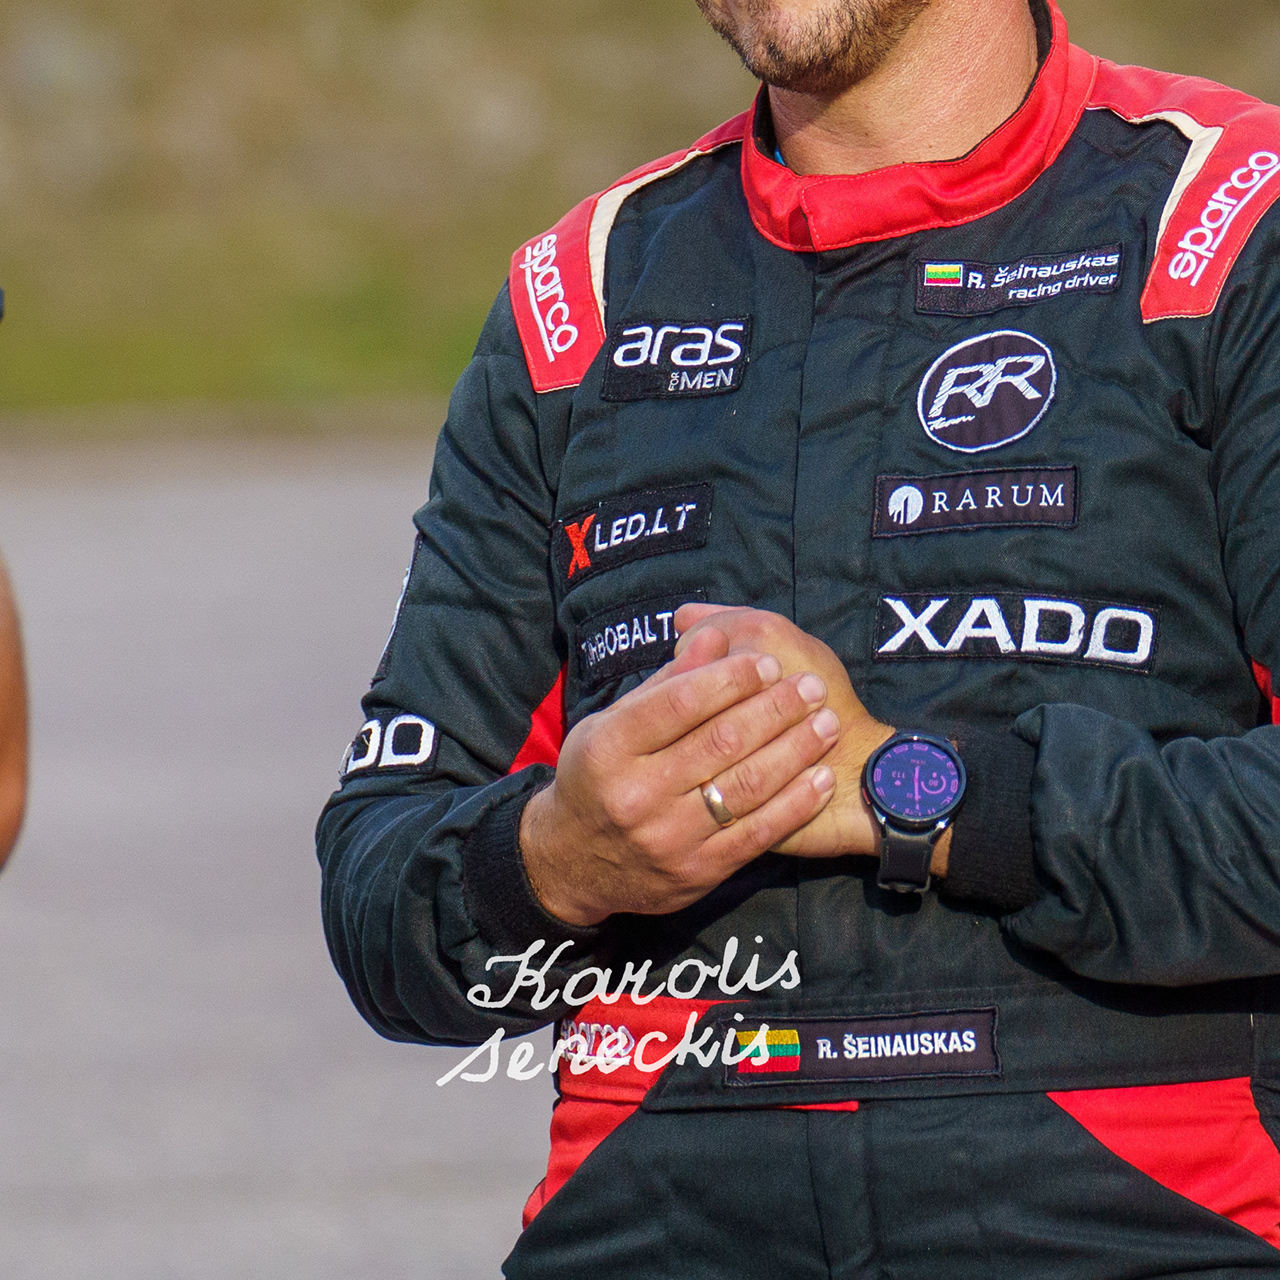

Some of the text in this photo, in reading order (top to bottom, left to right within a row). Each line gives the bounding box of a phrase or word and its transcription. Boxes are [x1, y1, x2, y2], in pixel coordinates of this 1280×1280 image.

[967, 253, 1120, 289] R. Šeinauskas
[1008, 272, 1118, 299] racing driver
[520, 233, 579, 363] sparco
[613, 323, 744, 367] aras
[679, 367, 734, 391] MEN
[928, 354, 1046, 418] RR
[932, 483, 1066, 514] RARUM
[878, 597, 1154, 665] XADO
[816, 1030, 976, 1060] R. ŠEINAUSKAS
